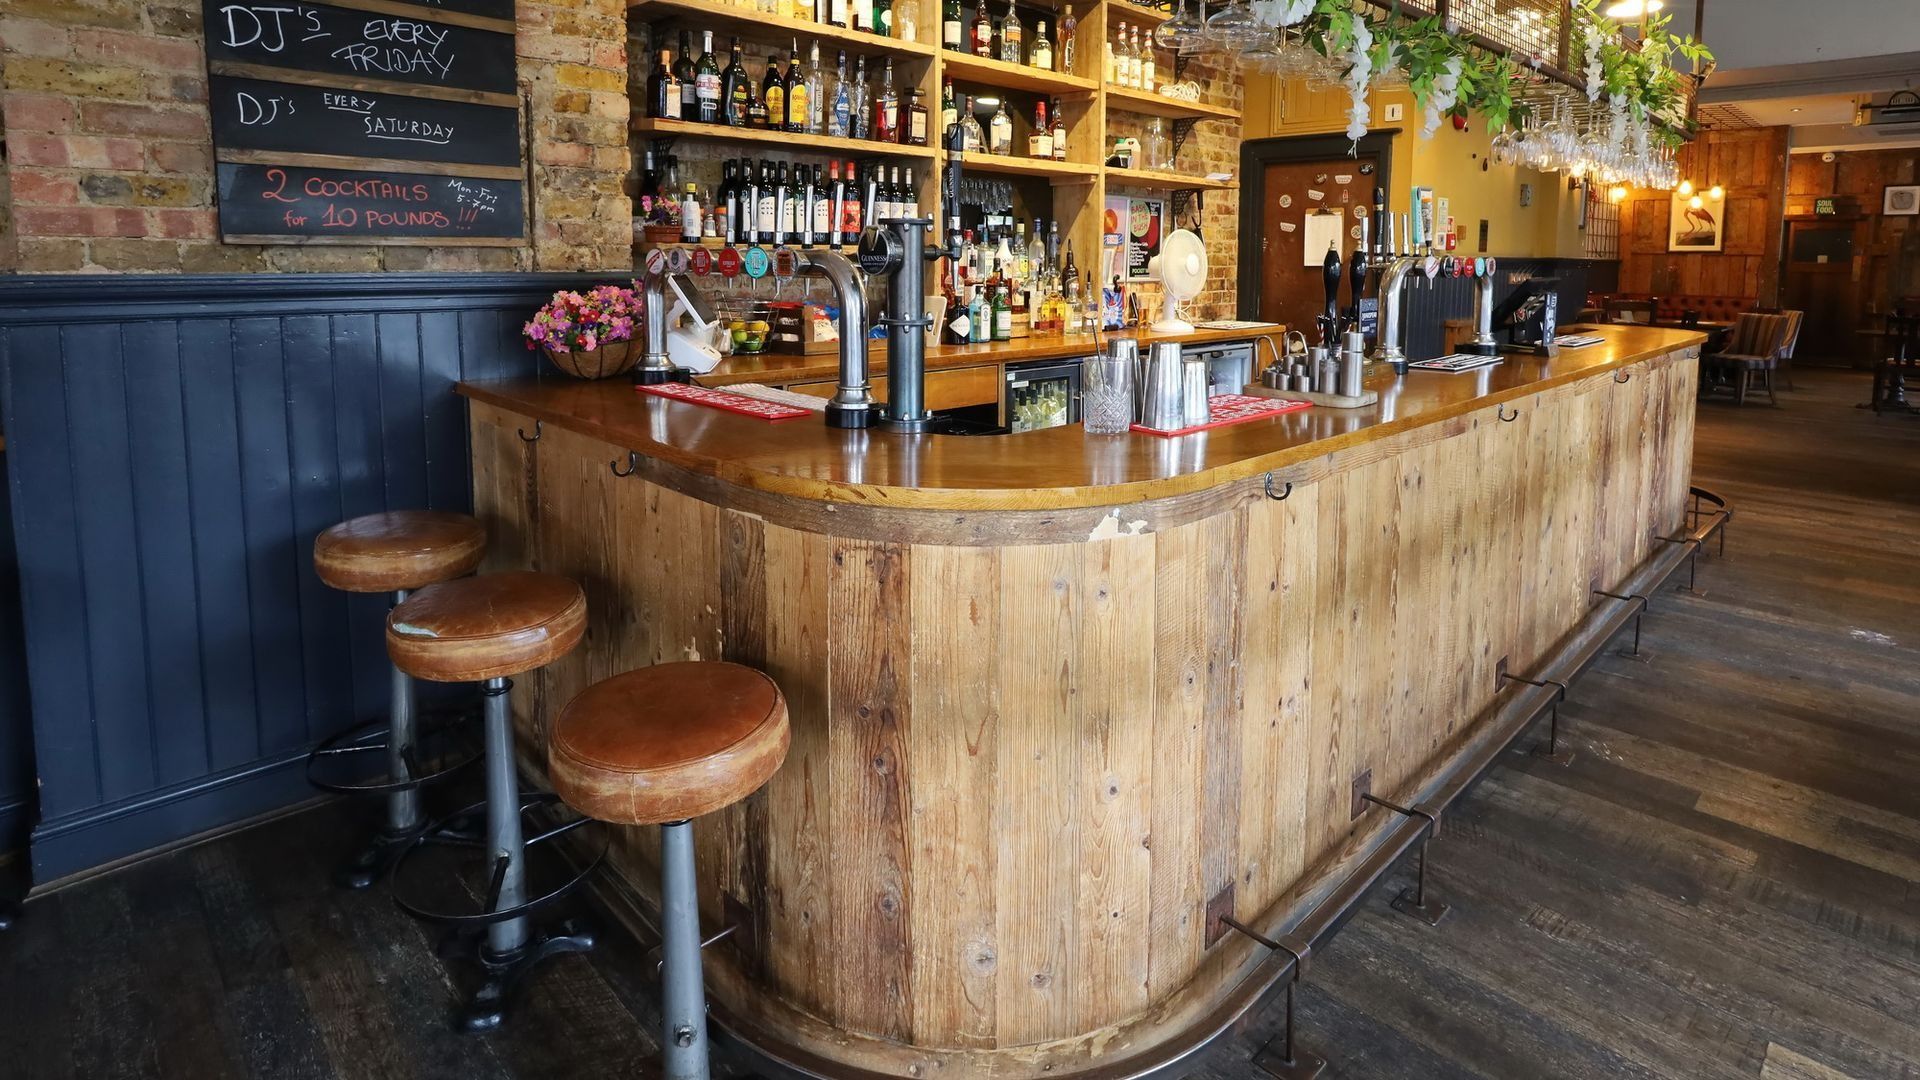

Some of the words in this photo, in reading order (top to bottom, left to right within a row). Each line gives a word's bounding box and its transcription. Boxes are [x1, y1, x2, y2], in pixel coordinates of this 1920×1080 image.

[364, 19, 448, 54] EVERY
[331, 43, 454, 79] FRIDAY
[323, 93, 376, 110] EVERY
[364, 117, 454, 139] SATURDAY
[262, 169, 301, 203] 2
[304, 176, 429, 202] COCKTAILS
[283, 212, 308, 227] for
[322, 203, 357, 228] 10
[367, 210, 450, 229] POUNDS
